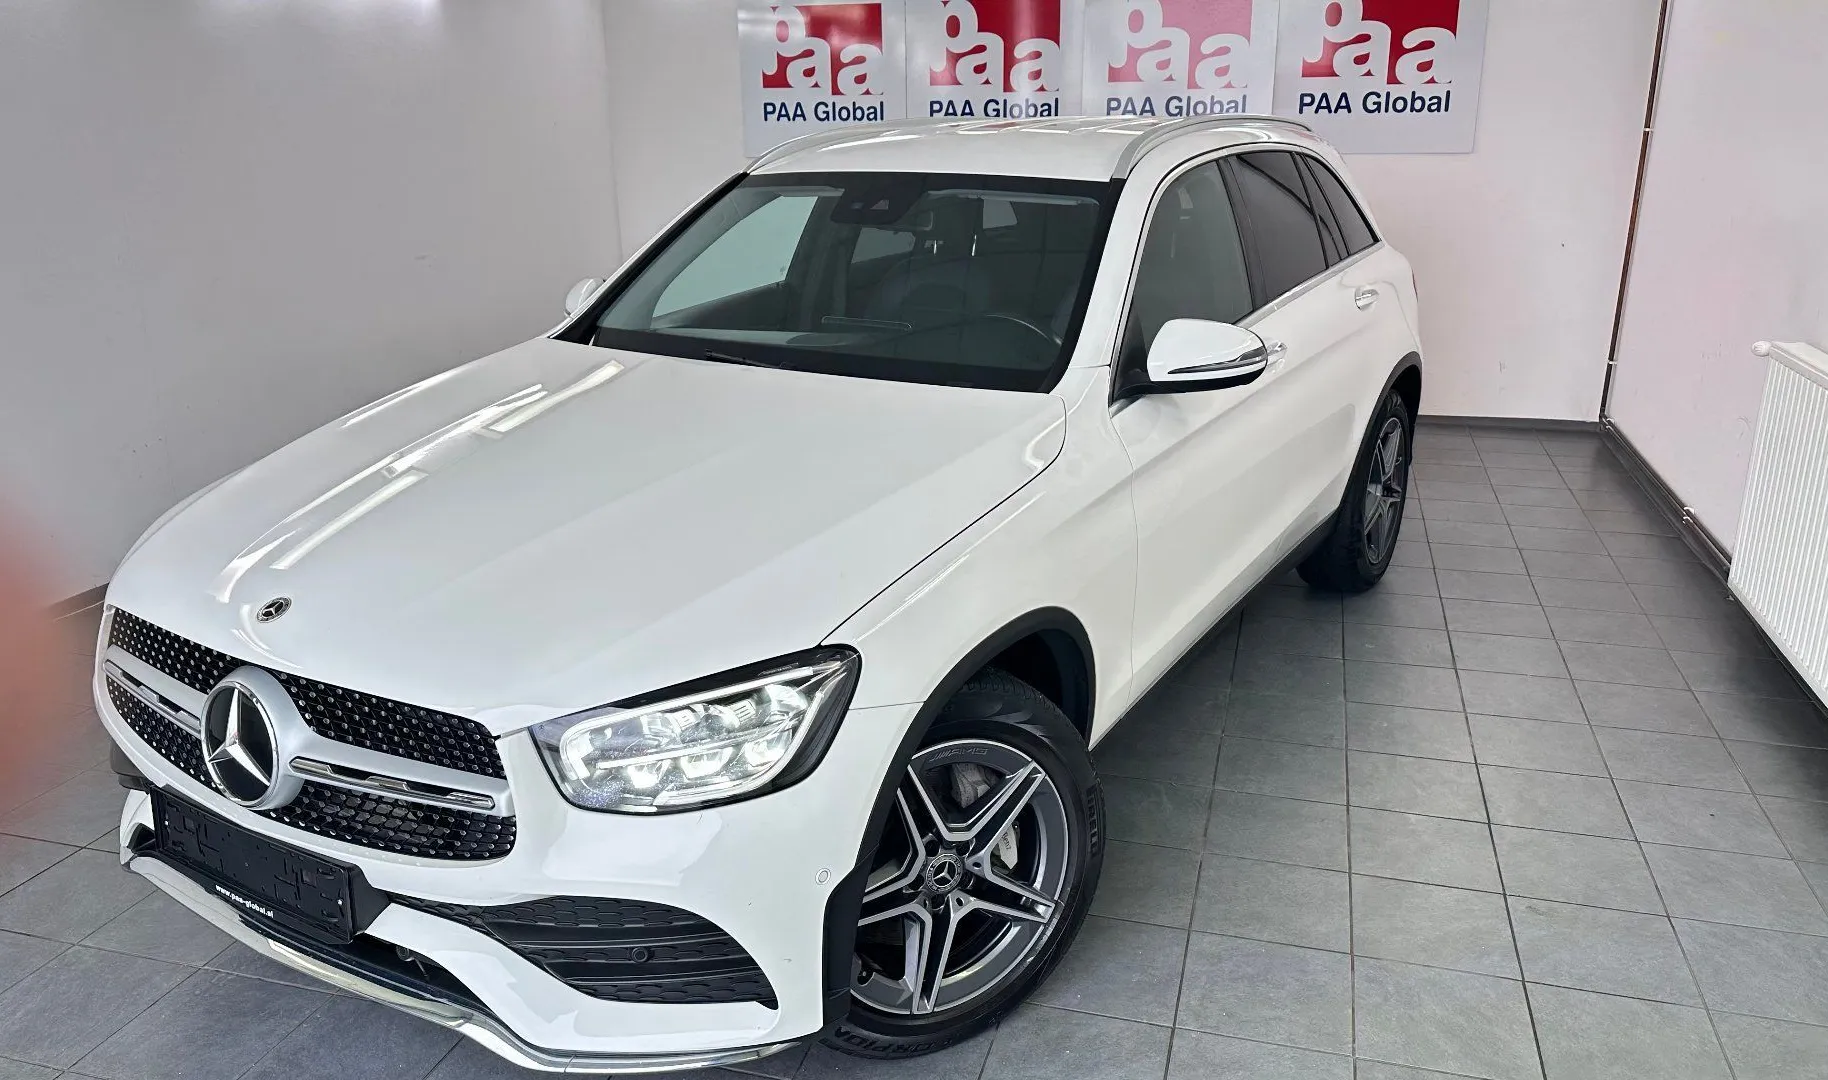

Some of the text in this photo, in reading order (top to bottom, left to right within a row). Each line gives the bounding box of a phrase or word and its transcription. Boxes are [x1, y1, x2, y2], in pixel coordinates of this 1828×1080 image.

[763, 101, 884, 122] PAA Global
[929, 97, 1058, 118] PAA Global
[1106, 94, 1247, 117] PAA Global
[1299, 90, 1451, 114] PAA Global
